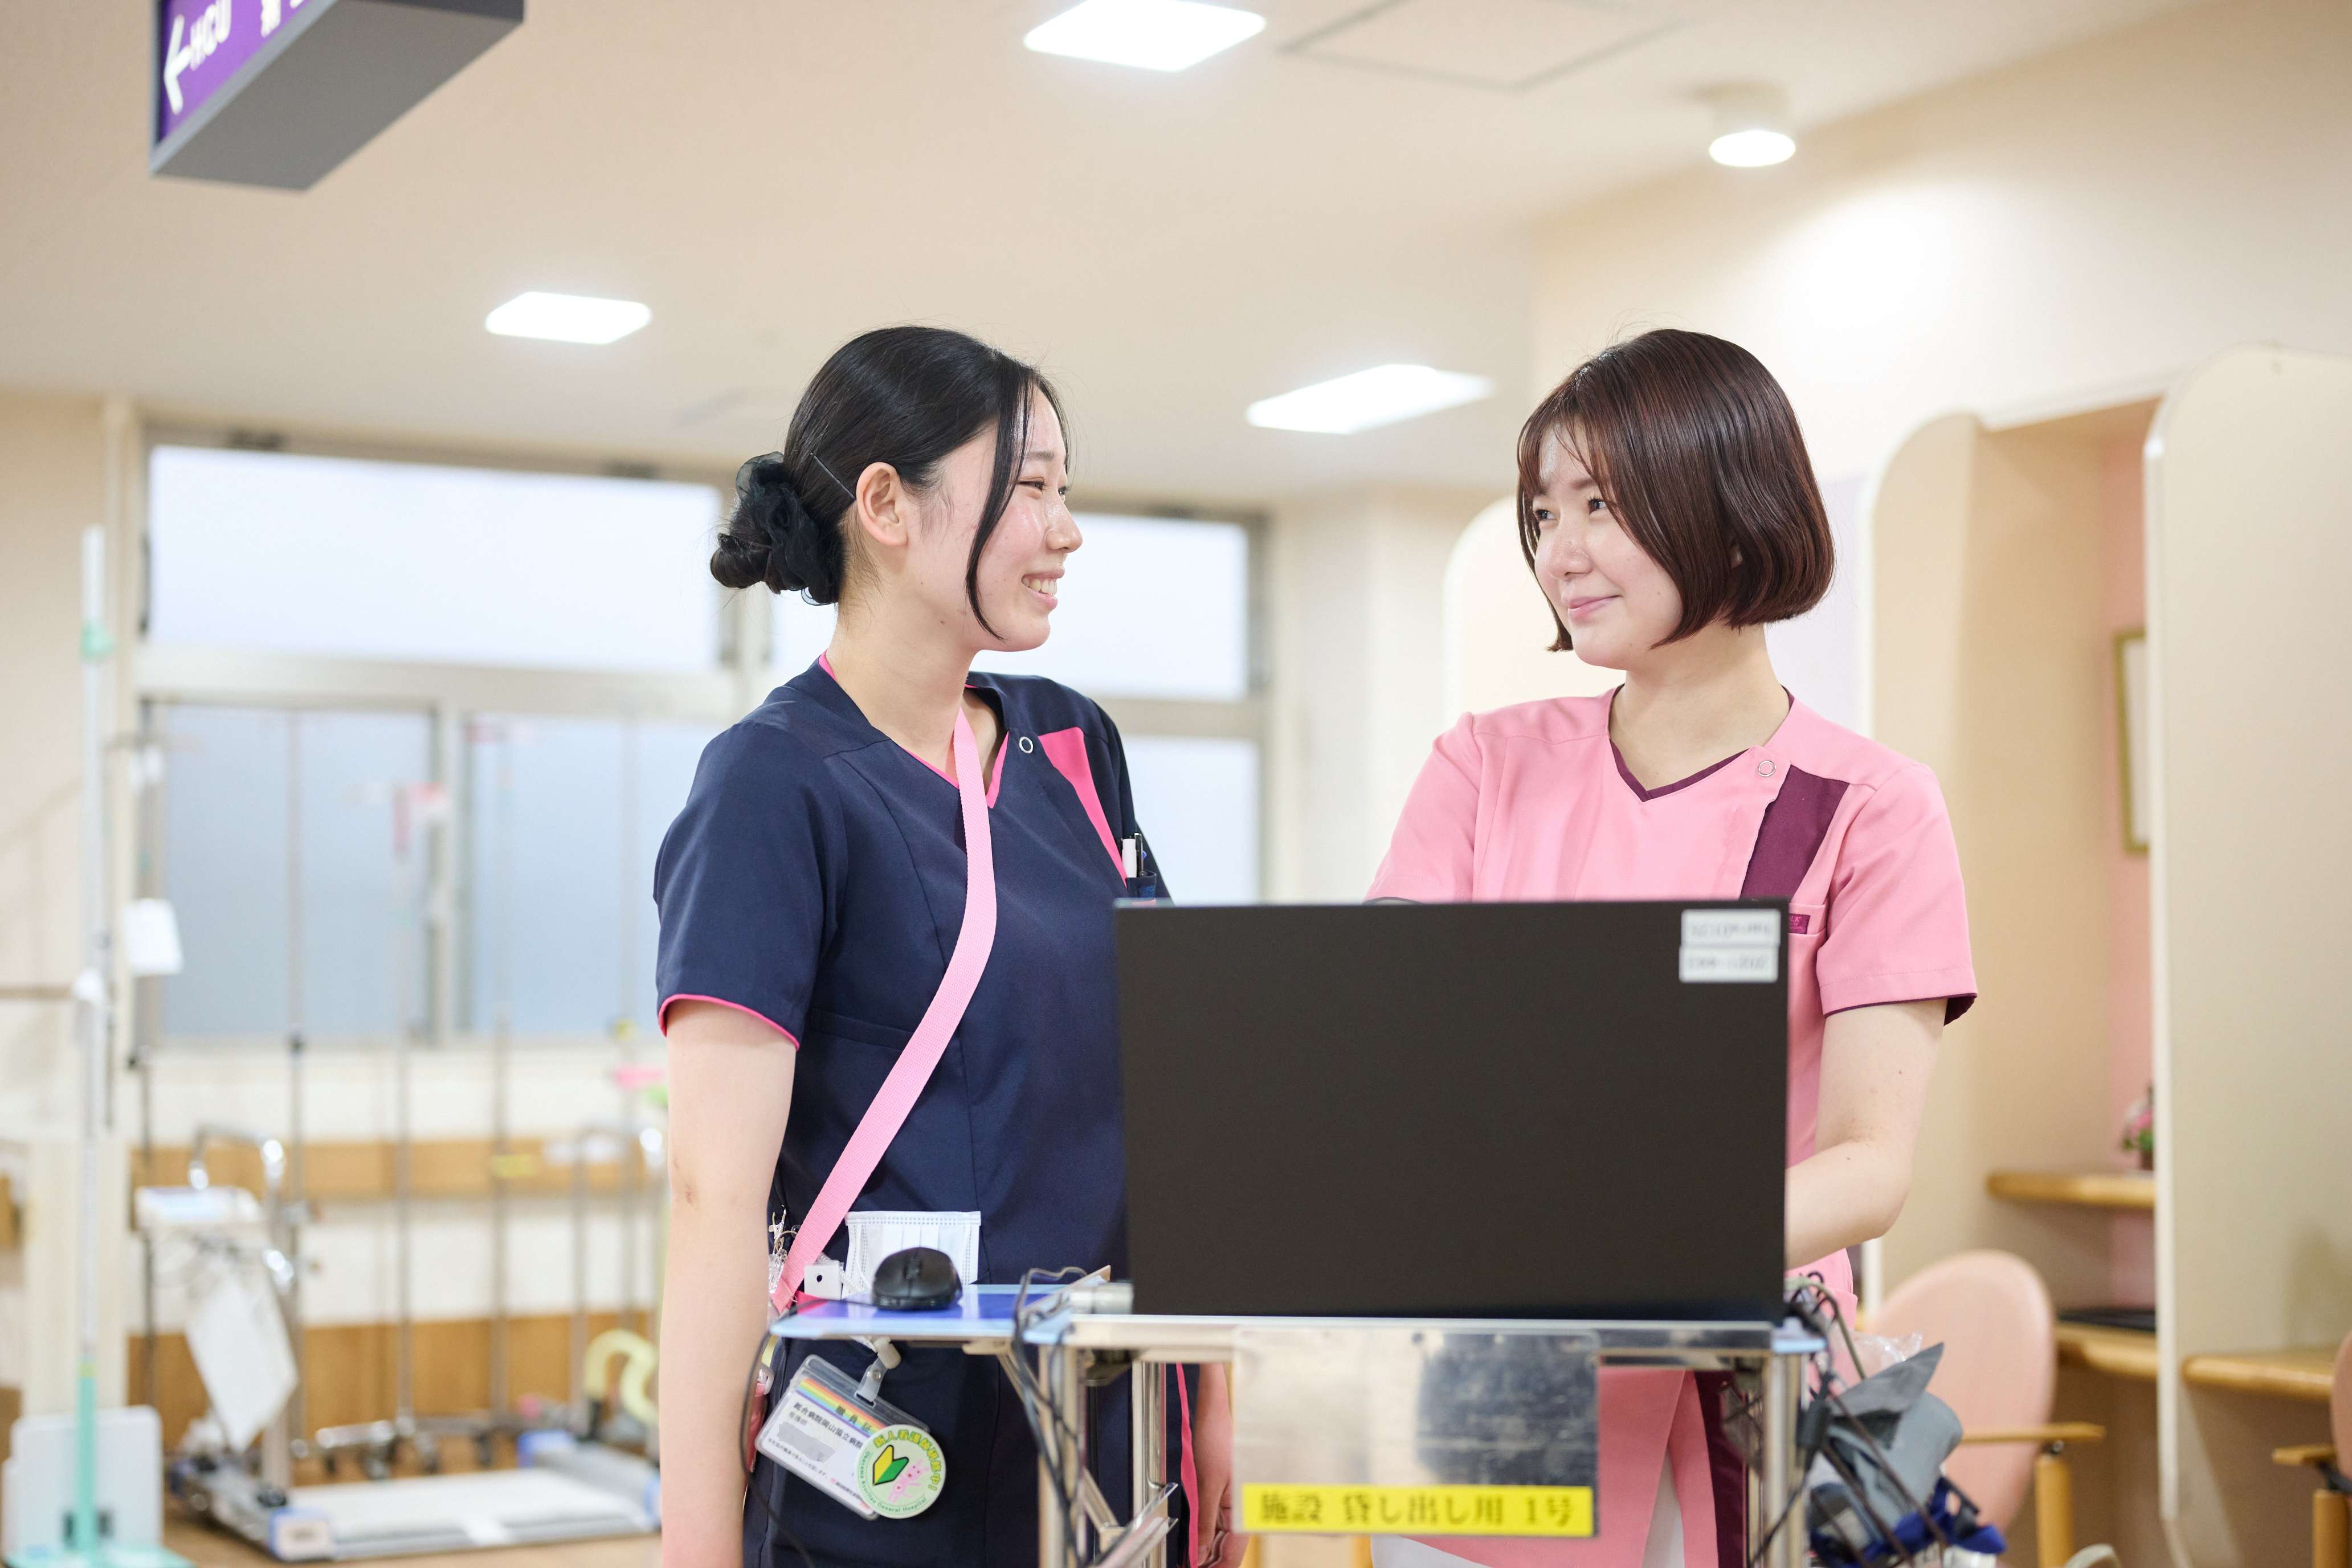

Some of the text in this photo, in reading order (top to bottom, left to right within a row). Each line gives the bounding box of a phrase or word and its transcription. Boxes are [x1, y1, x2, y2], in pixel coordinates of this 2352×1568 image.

[835, 1404, 872, 1432] 職員証
[877, 1501, 901, 1512] General
[903, 1497, 927, 1512] Hospital
[1261, 1493, 1322, 1524] 施設
[1343, 1493, 1503, 1525] 貸し出し用
